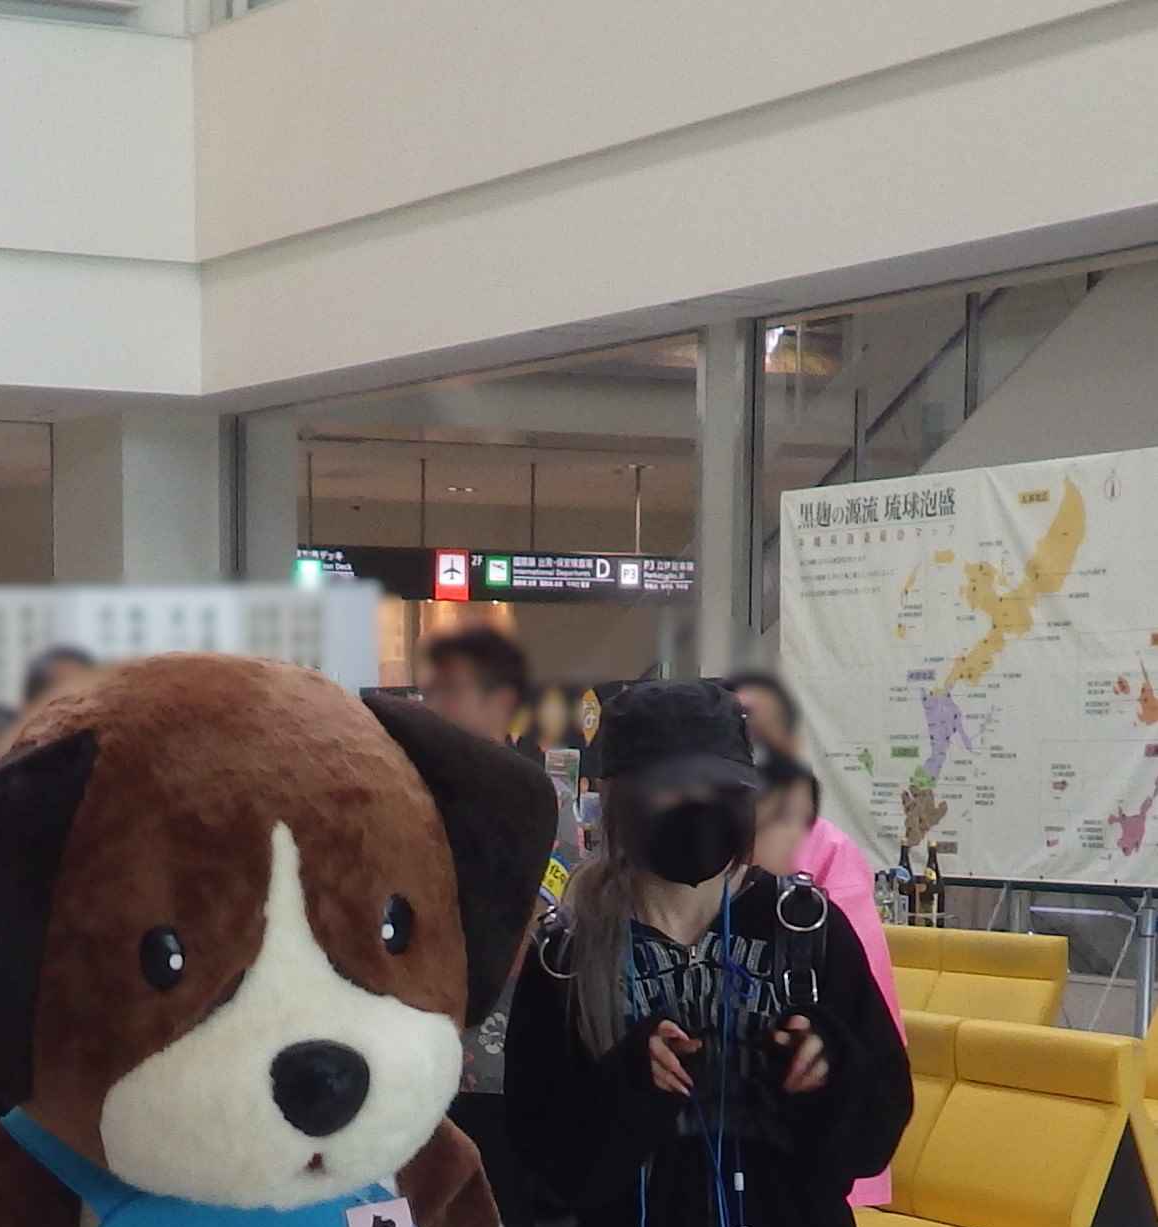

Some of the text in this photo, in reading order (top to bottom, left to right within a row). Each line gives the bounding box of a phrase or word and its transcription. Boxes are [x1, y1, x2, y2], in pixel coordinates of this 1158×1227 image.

[884, 487, 956, 521] 琉球泡盛
[595, 558, 611, 578] D
